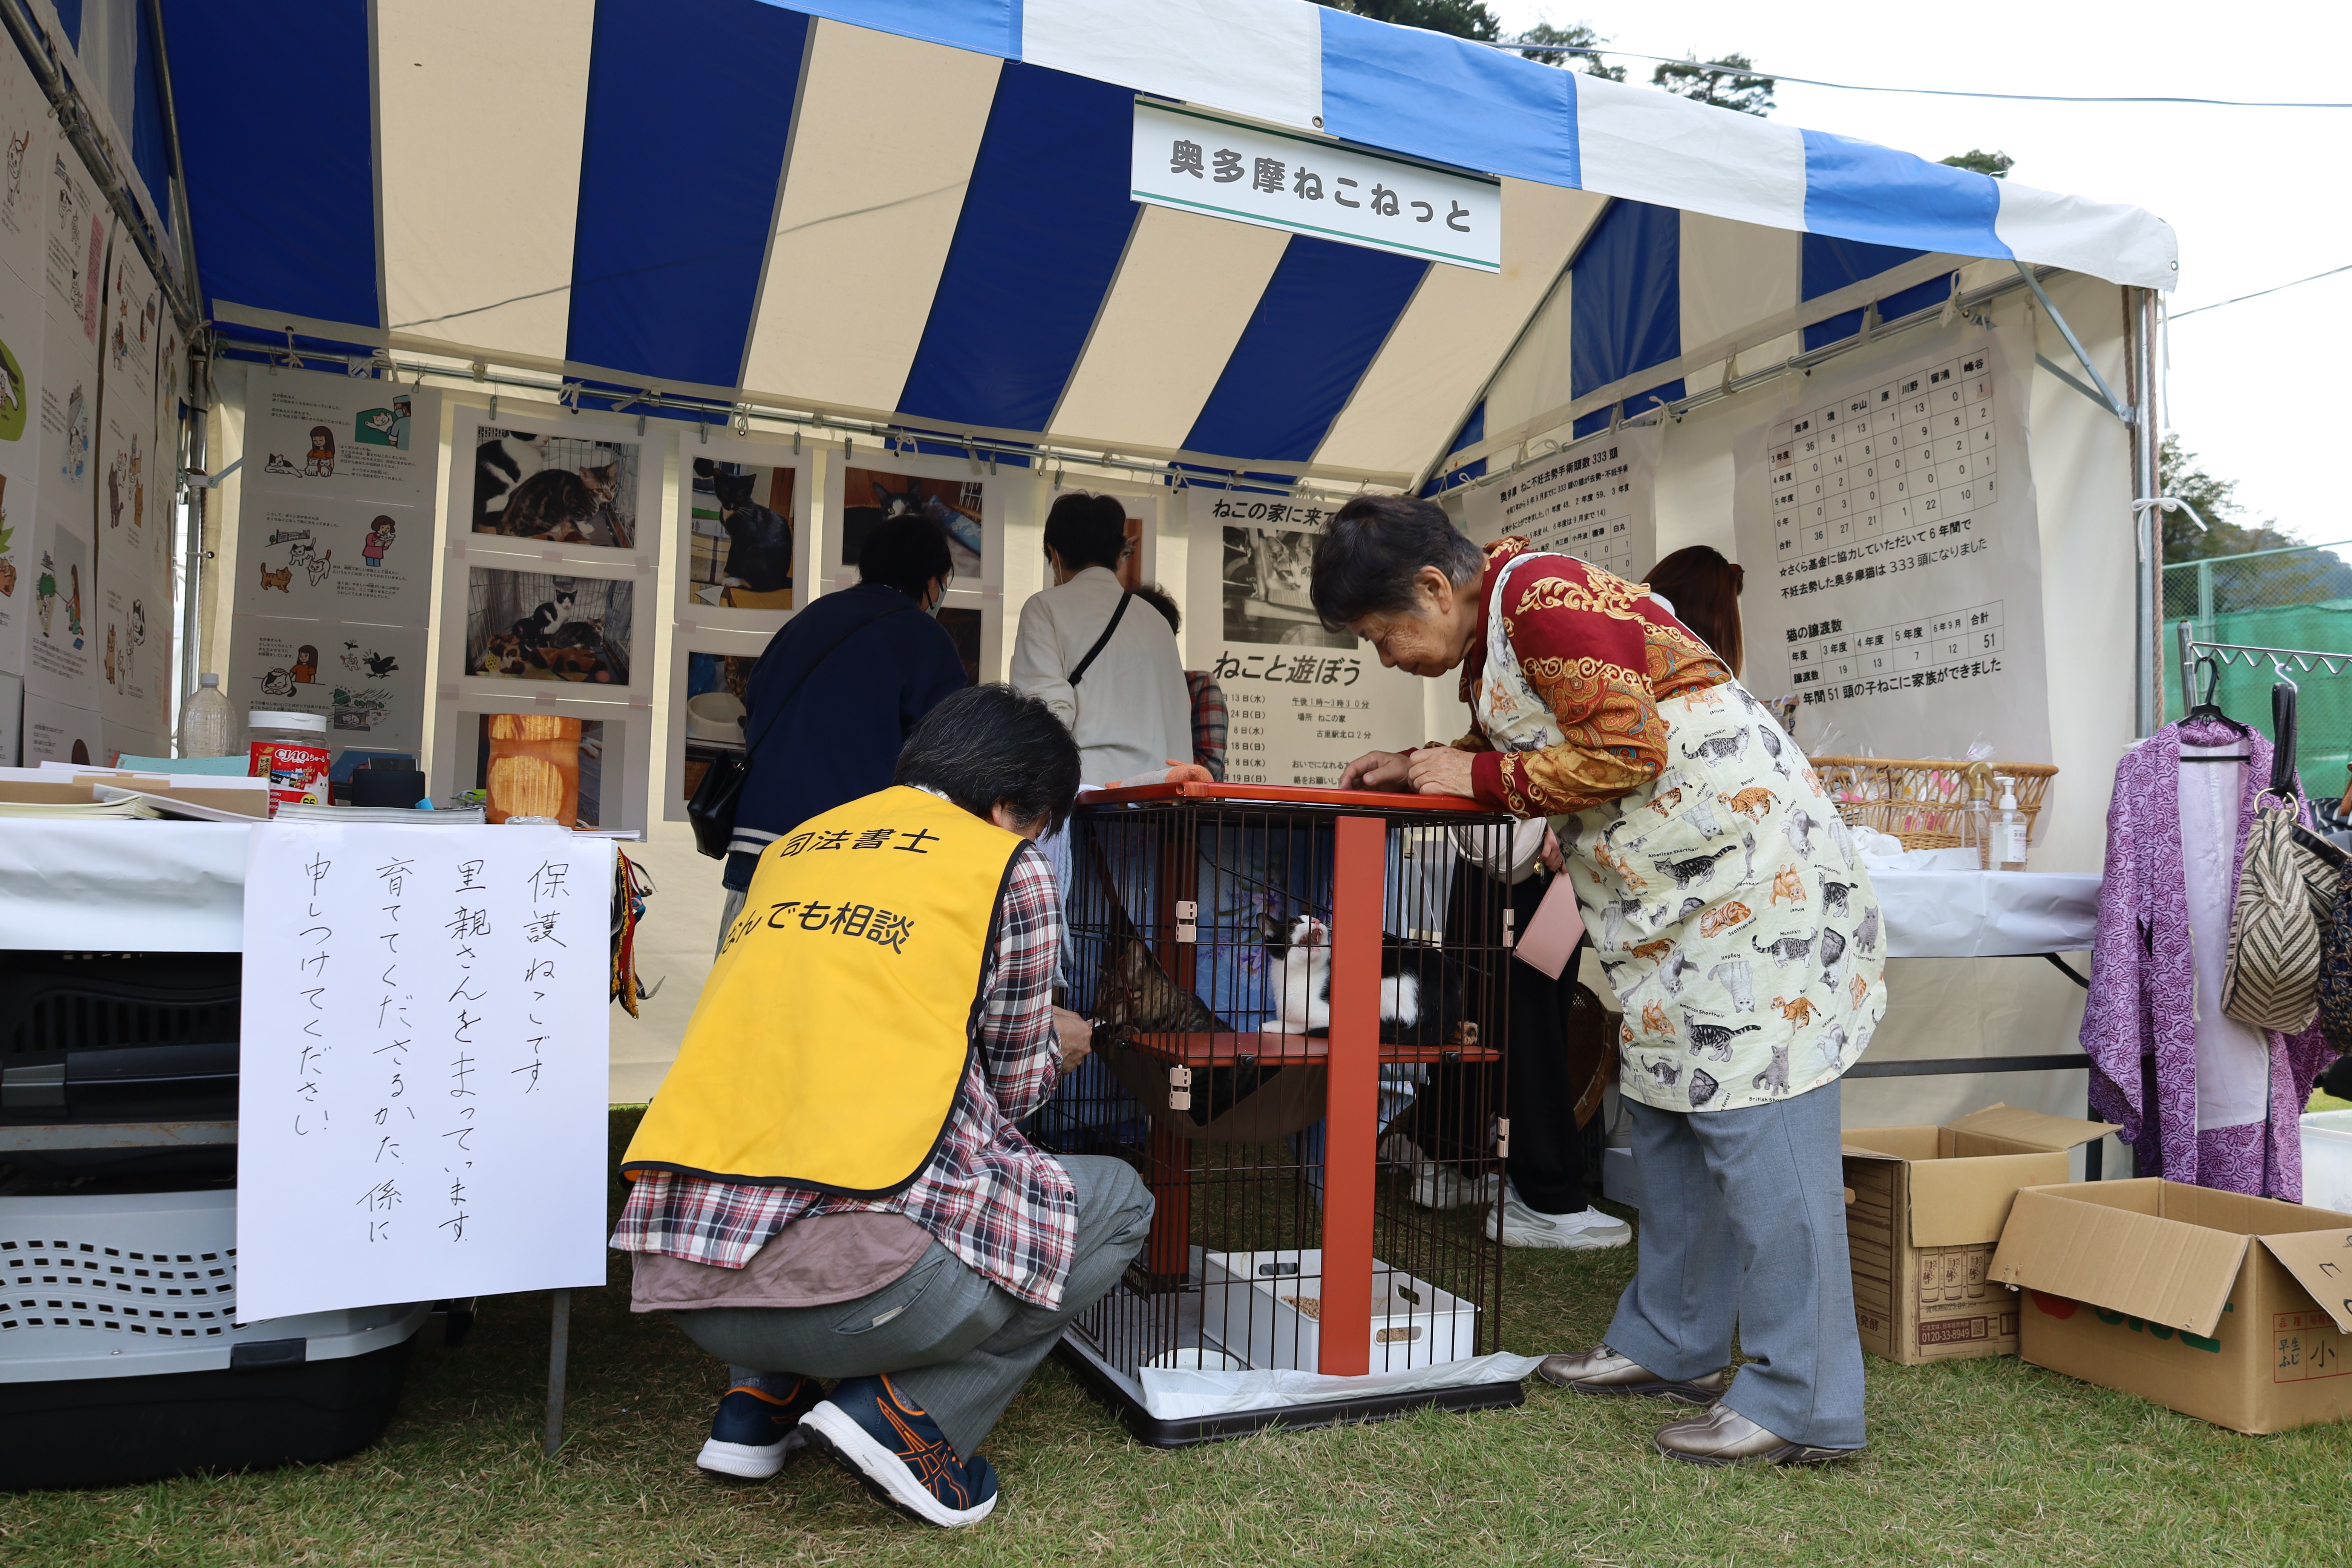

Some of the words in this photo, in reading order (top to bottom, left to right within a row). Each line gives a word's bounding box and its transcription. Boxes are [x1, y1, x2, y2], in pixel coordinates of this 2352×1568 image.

[1170, 139, 1470, 233] 奥多摩ねこねっと
[1851, 400, 1867, 412] 中山
[1881, 390, 1890, 402] 原
[1902, 380, 1918, 395] 川野
[1806, 442, 1814, 451] 36
[1831, 434, 1835, 443] 8
[1857, 423, 1866, 433] 13
[1891, 412, 1894, 421] 1
[1915, 403, 1925, 413] 13
[1952, 392, 1958, 401] 0
[1979, 384, 1982, 392] 1
[1813, 463, 1818, 472] 0
[1834, 455, 1842, 465] 14
[1865, 446, 1870, 454] 8
[1893, 436, 1897, 445] 0
[1922, 427, 1927, 436] 9
[1954, 417, 1959, 426] 8
[1981, 408, 1986, 418] 2
[1816, 485, 1820, 493] 0
[1839, 478, 1843, 486] 2
[1868, 468, 1873, 477] 0
[1895, 459, 1899, 468] 0
[1925, 450, 1929, 459] 0
[1957, 440, 1962, 450] 2
[1985, 431, 1989, 441] 4
[1818, 507, 1821, 515] 0
[1842, 499, 1846, 508] 3
[1870, 492, 1874, 500] 0
[1899, 482, 1903, 492] 0
[1928, 474, 1933, 483] 0
[1959, 465, 1965, 474] 0
[1986, 456, 1989, 465] 1
[1614, 523, 1625, 533] 白丸
[1779, 540, 1792, 550] 合計
[1815, 531, 1823, 540] 36
[1841, 523, 1848, 533] 27
[1868, 516, 1876, 525] 21
[1902, 507, 1906, 516] 1
[1926, 499, 1936, 510] 22
[1961, 489, 1970, 500] 10
[1989, 481, 1993, 491] 8
[1792, 650, 1808, 662] 年度
[1971, 611, 1989, 625] 合計
[1212, 651, 1361, 686] ねこと遊ぼう
[1839, 665, 1847, 674] 19
[1873, 658, 1882, 668] 13
[1914, 652, 1919, 660] 7
[1949, 644, 1957, 654] 12
[1984, 633, 1994, 648] 51
[1297, 713, 1312, 722] 場所
[1318, 714, 1346, 723] ねこの家
[1704, 729, 1726, 738] Munchkin
[275, 749, 309, 762] CIAO
[1740, 776, 1755, 787] Bengal
[780, 828, 940, 858] 司法書士
[1728, 922, 1747, 936] Scottish
[1679, 1003, 1698, 1013] American
[1698, 1009, 1725, 1019] Shorthair
[1922, 1328, 1969, 1343] 0120-33-8949
